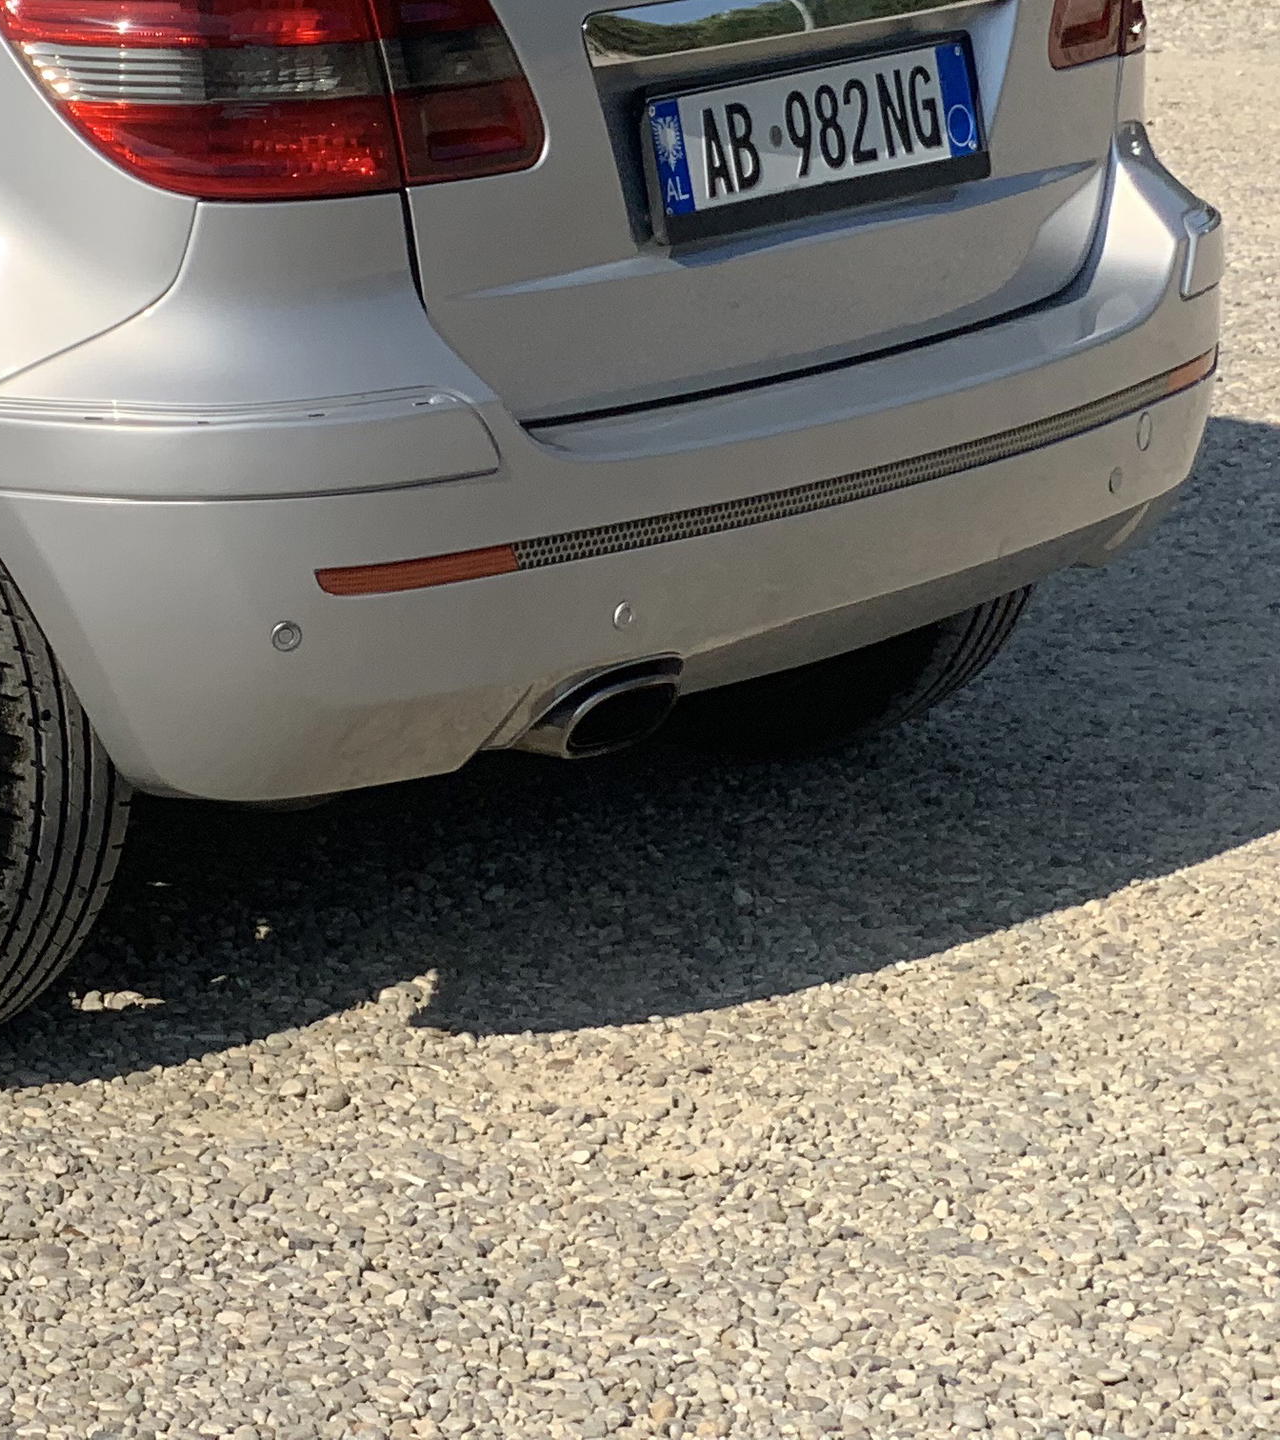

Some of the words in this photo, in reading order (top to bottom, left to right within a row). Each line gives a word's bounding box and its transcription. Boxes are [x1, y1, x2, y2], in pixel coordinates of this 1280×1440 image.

[701, 102, 761, 200] AB
[784, 64, 943, 179] 982NG
[667, 176, 690, 202] AL
